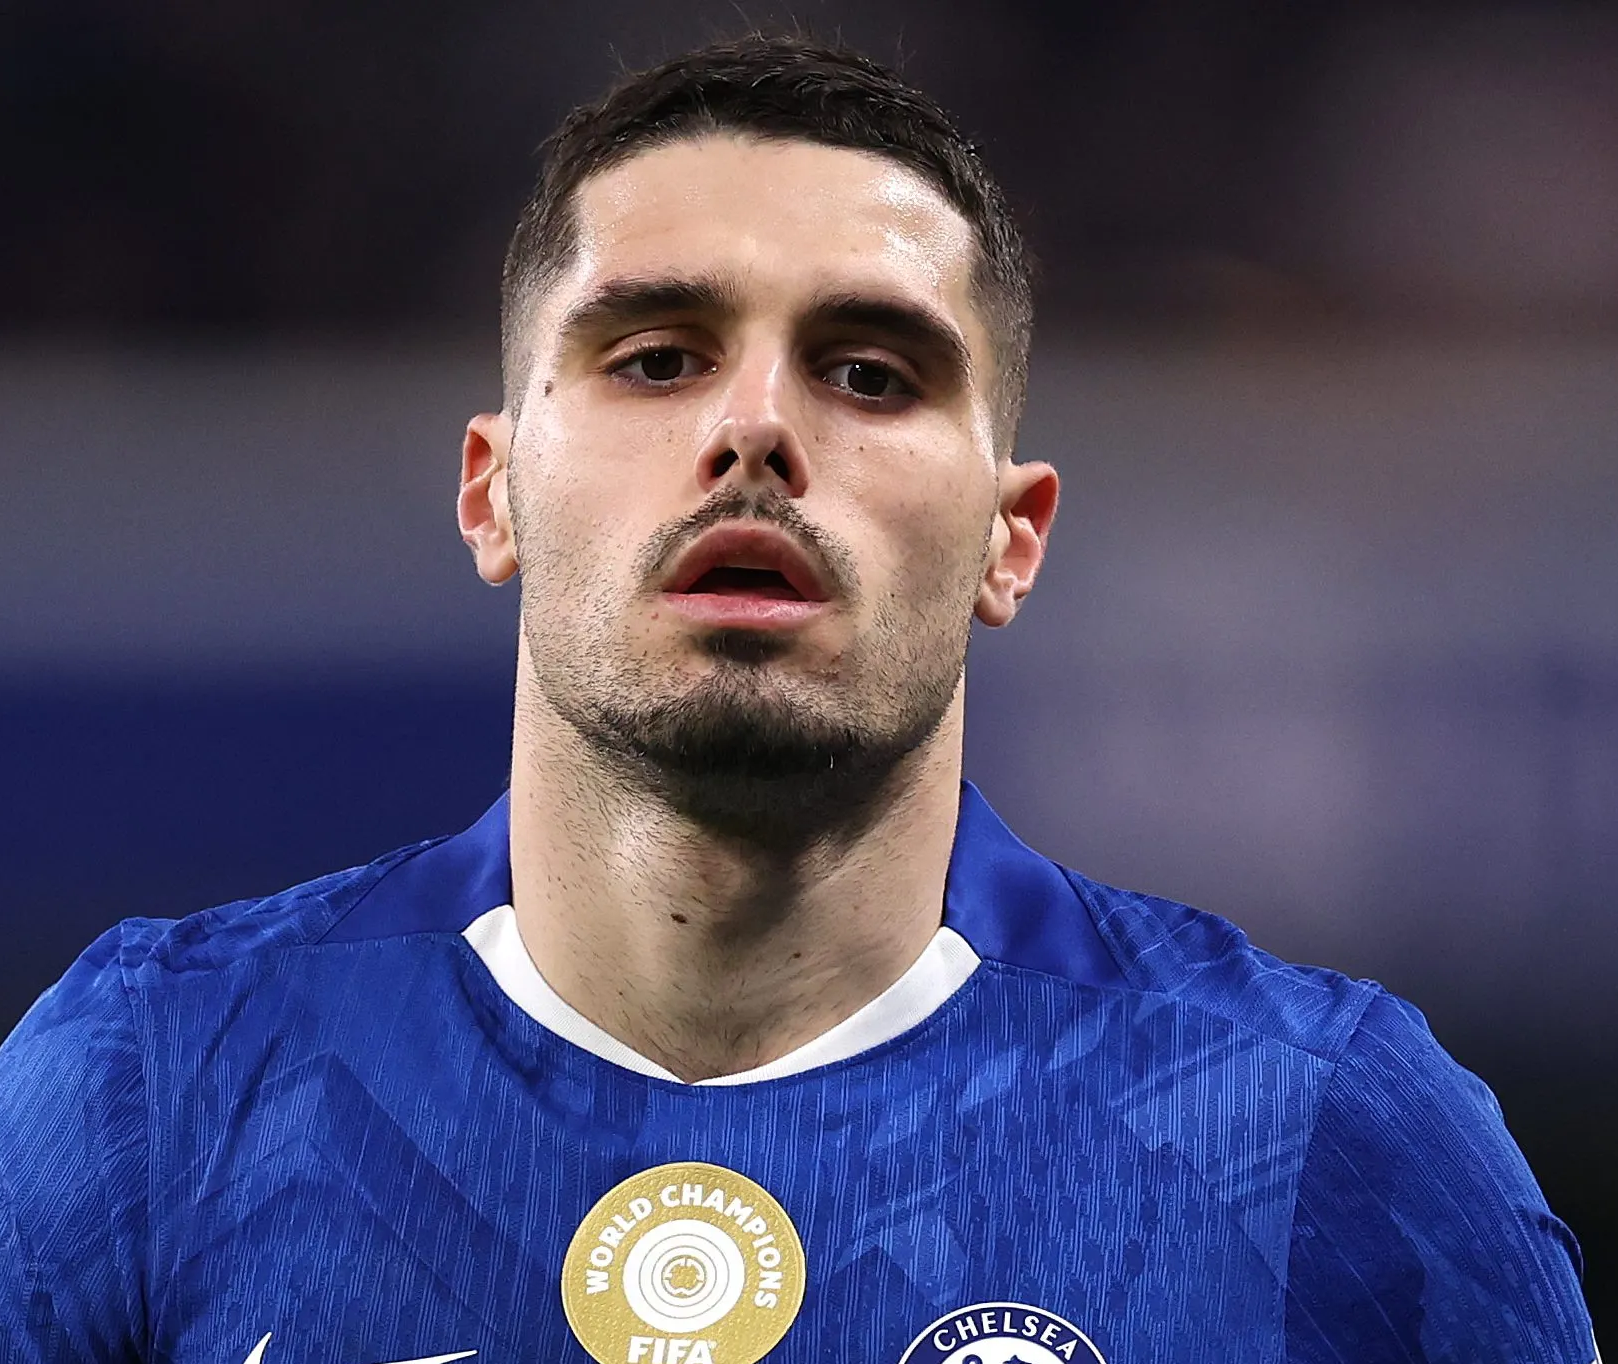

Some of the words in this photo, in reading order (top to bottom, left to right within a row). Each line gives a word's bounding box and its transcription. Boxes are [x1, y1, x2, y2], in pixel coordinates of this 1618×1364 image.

[586, 1197, 654, 1295] WORLD
[660, 1183, 784, 1310] CHAMPIONS
[933, 1311, 1079, 1361] CHELSEA
